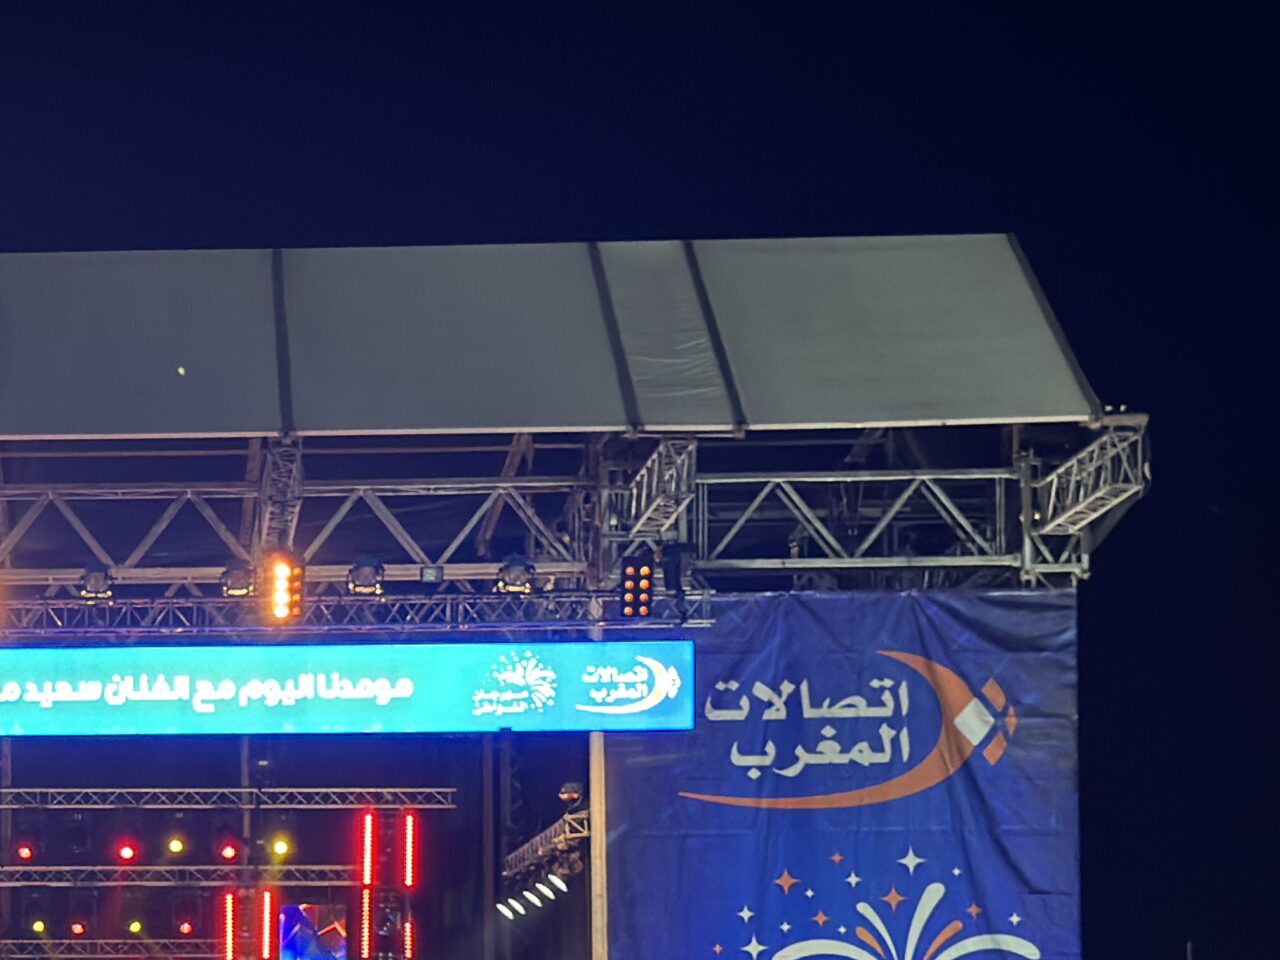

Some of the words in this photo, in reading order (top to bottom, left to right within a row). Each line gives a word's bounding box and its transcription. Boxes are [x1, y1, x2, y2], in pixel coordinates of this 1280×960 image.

[105, 674, 189, 704] الفنان
[193, 681, 235, 711] مع
[239, 674, 313, 706] اليوم
[318, 673, 412, 704] موعدنا
[704, 679, 910, 722] اتصالات
[730, 724, 910, 778] المغرب
